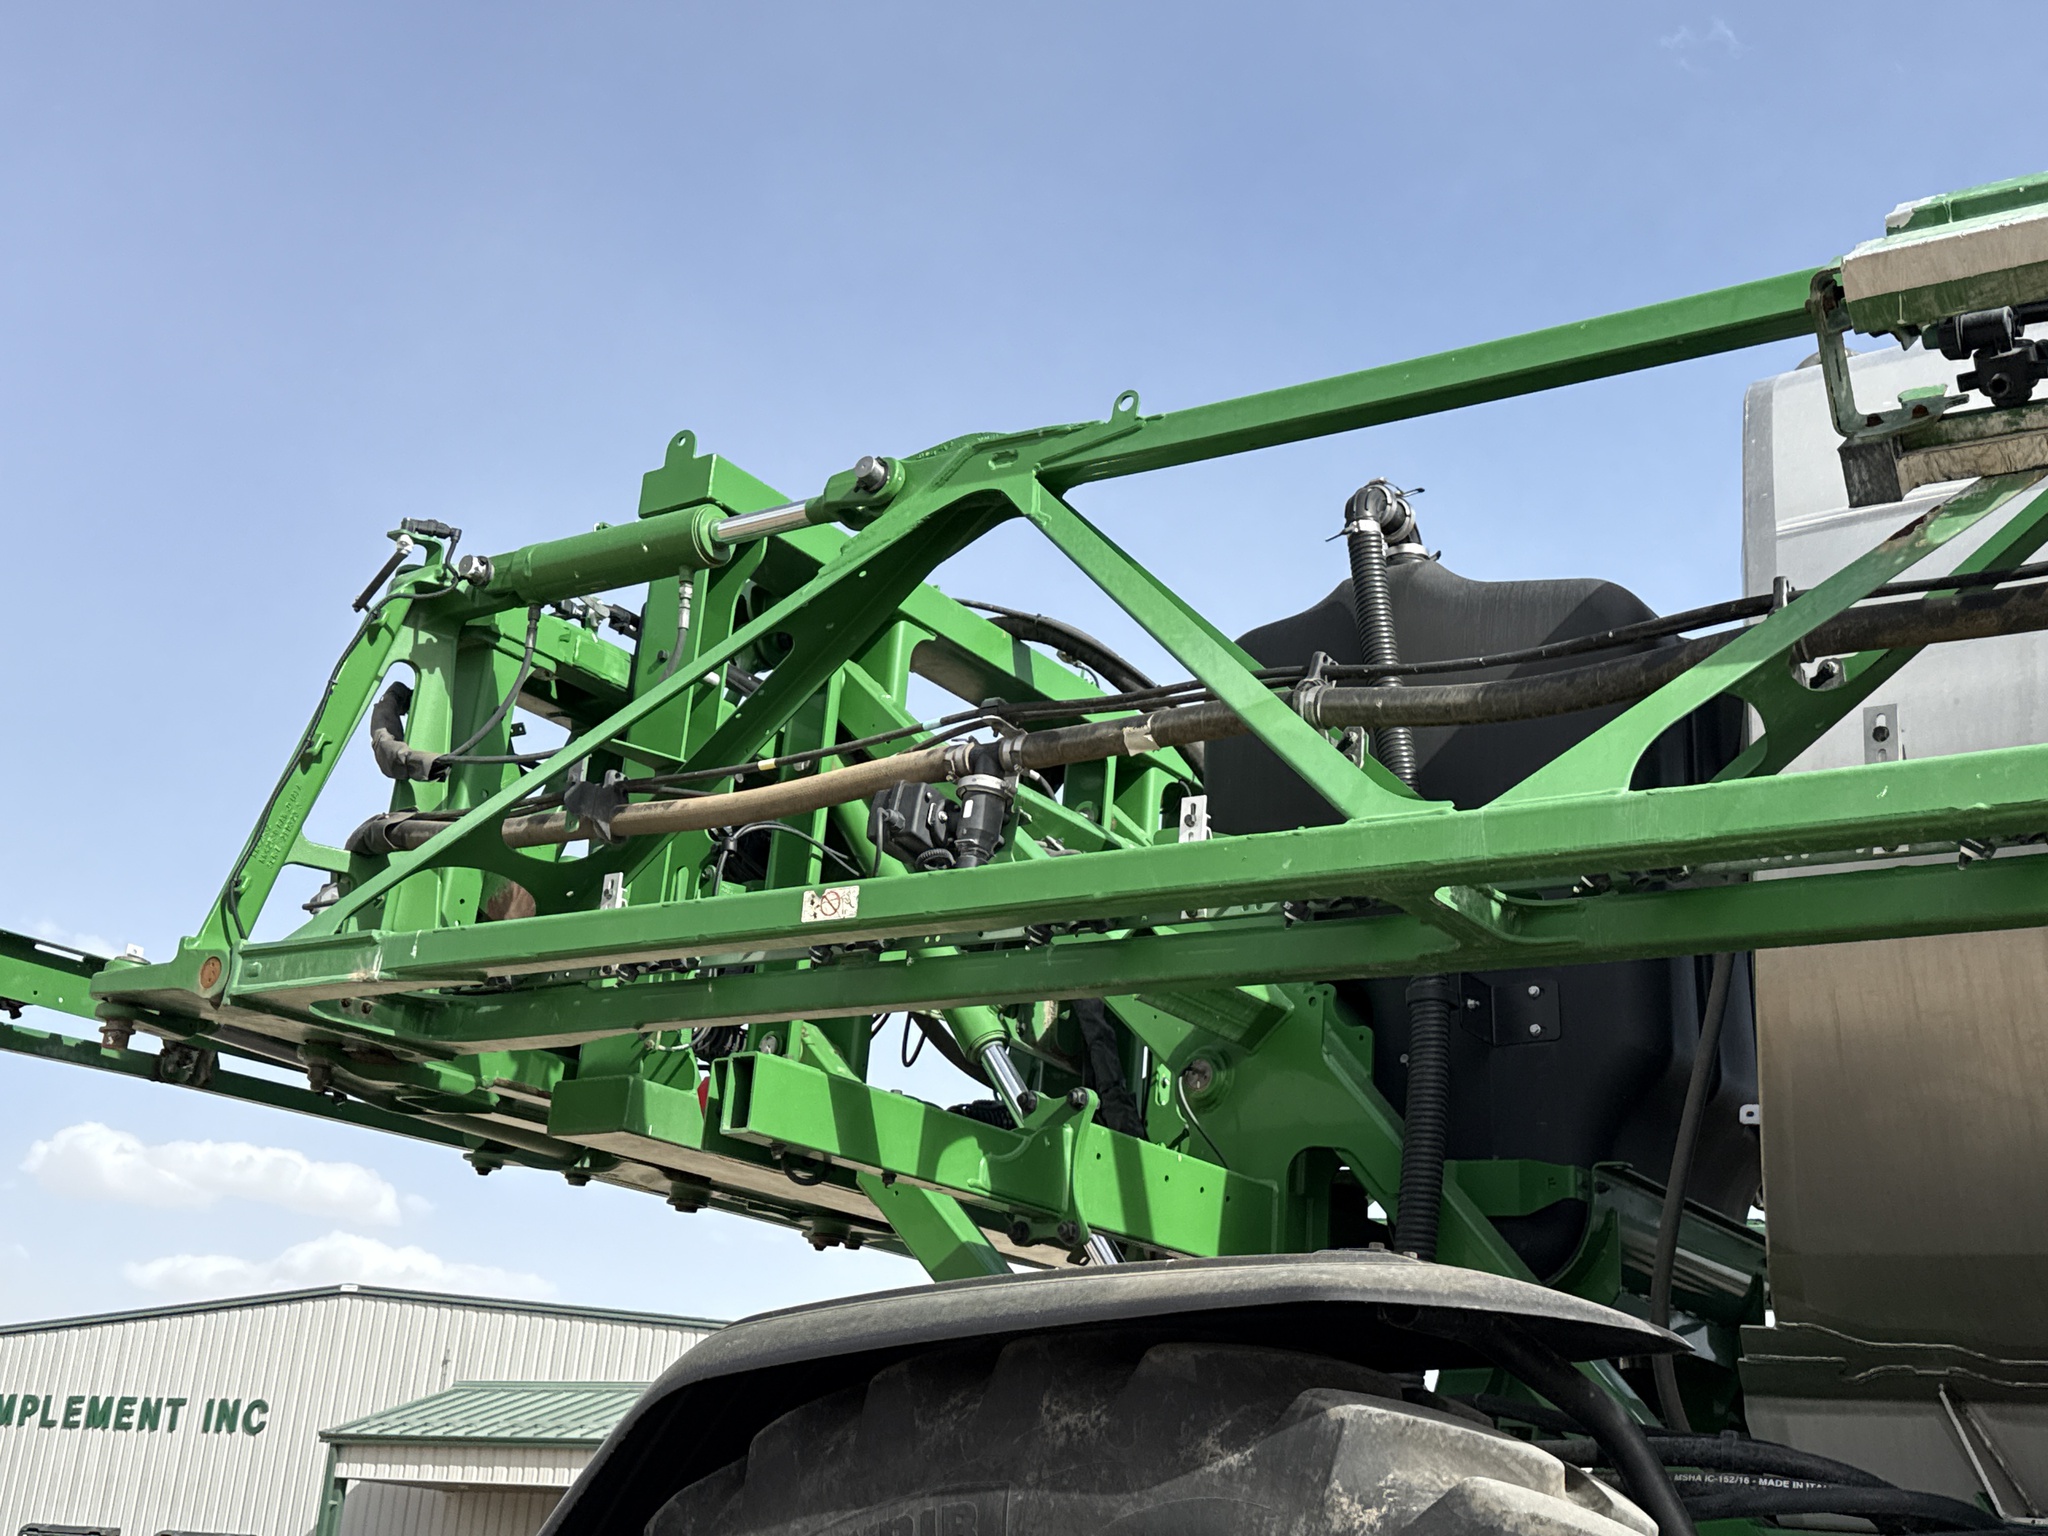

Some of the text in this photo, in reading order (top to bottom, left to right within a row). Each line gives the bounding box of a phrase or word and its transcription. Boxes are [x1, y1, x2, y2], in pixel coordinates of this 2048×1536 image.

[201, 1398, 269, 1436] INC
[1674, 1473, 1702, 1482] MSHA
[1758, 1477, 1790, 1488] MADE
[1792, 1481, 1804, 1489] IN
